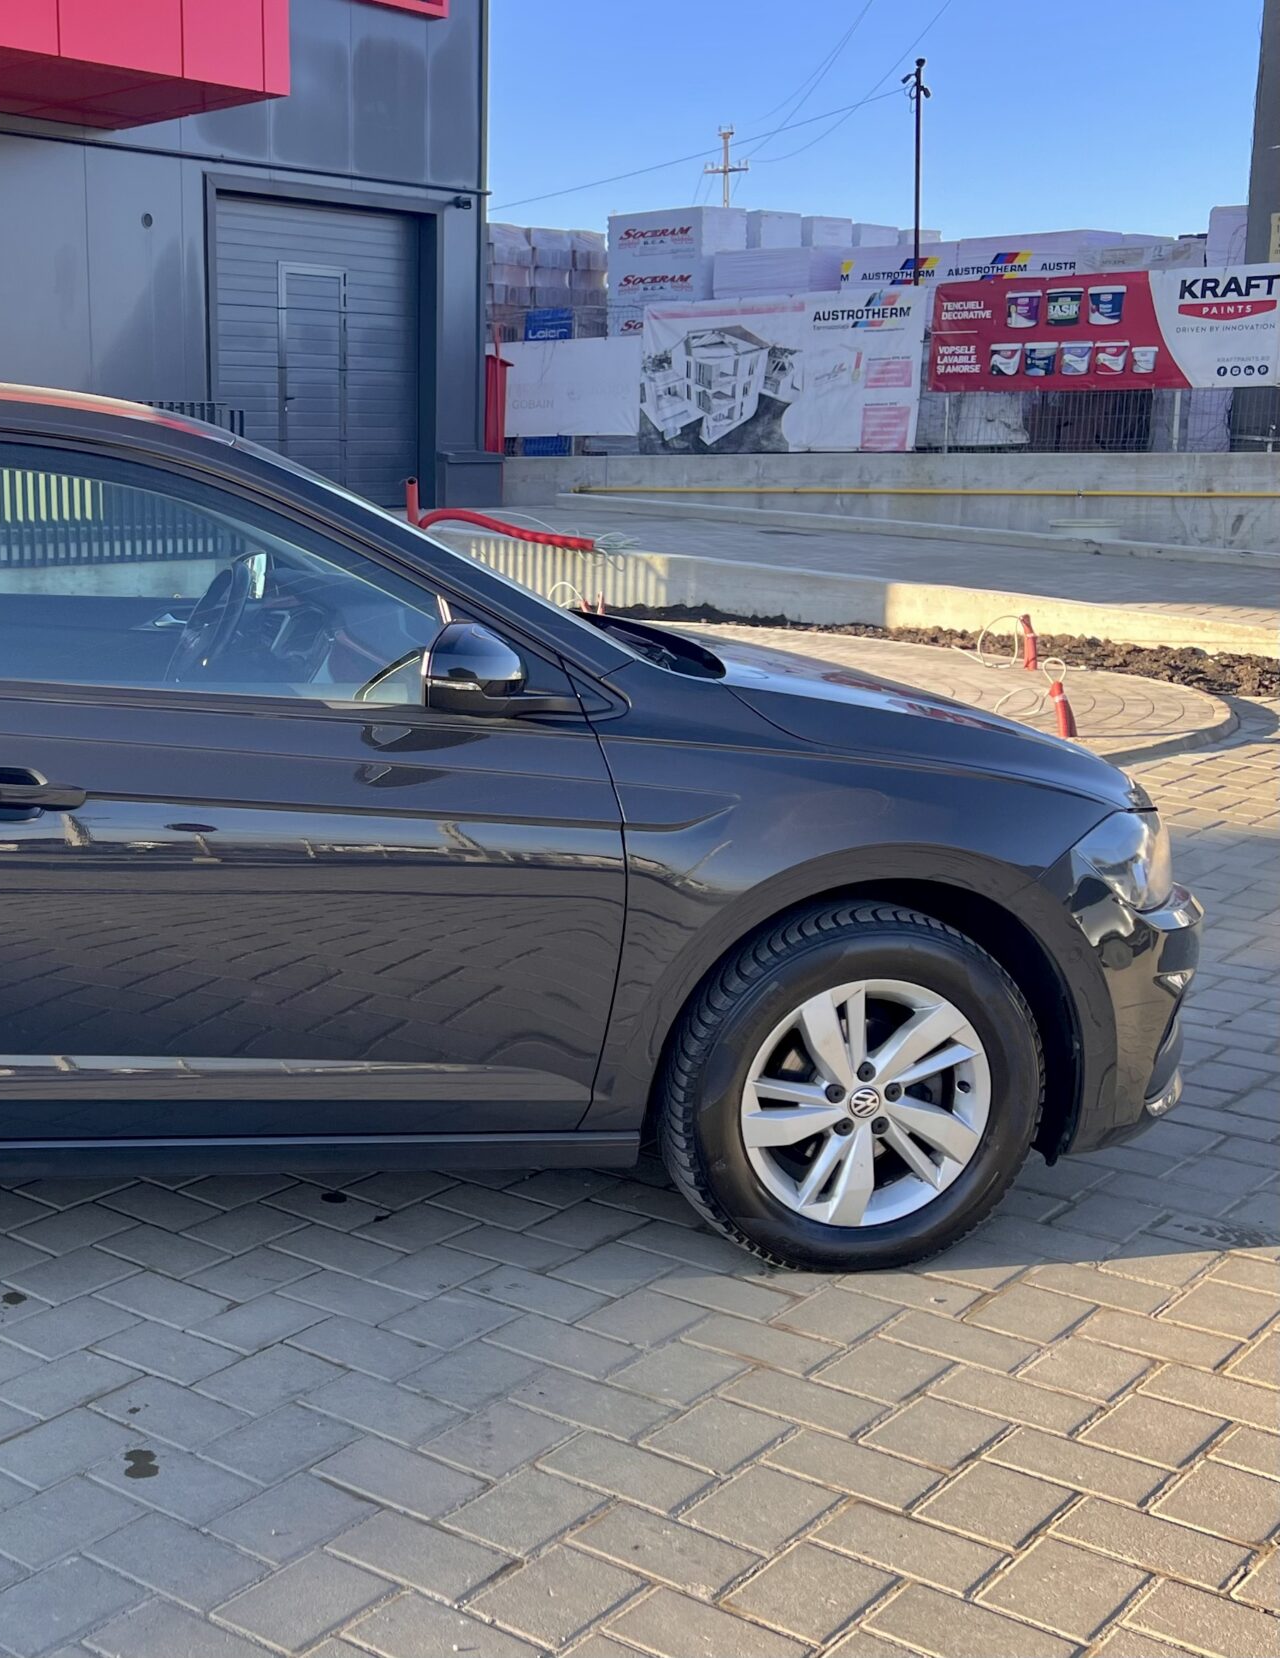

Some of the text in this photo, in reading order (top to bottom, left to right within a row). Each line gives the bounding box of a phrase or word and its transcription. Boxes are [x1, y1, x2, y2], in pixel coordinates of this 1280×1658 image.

[947, 264, 1028, 277] AUSTROTHERM
[1179, 274, 1280, 299] KRAFT
[942, 300, 984, 310] TENCUIELI
[1202, 304, 1252, 315] PAINTS
[813, 306, 912, 322] AUSTROTHERM
[941, 310, 992, 320] DECORATIVE
[1222, 323, 1275, 331] INNOVATION
[938, 345, 976, 355] VOPSELE
[937, 355, 977, 364] LAVABILE
[945, 364, 981, 374] AMORSE
